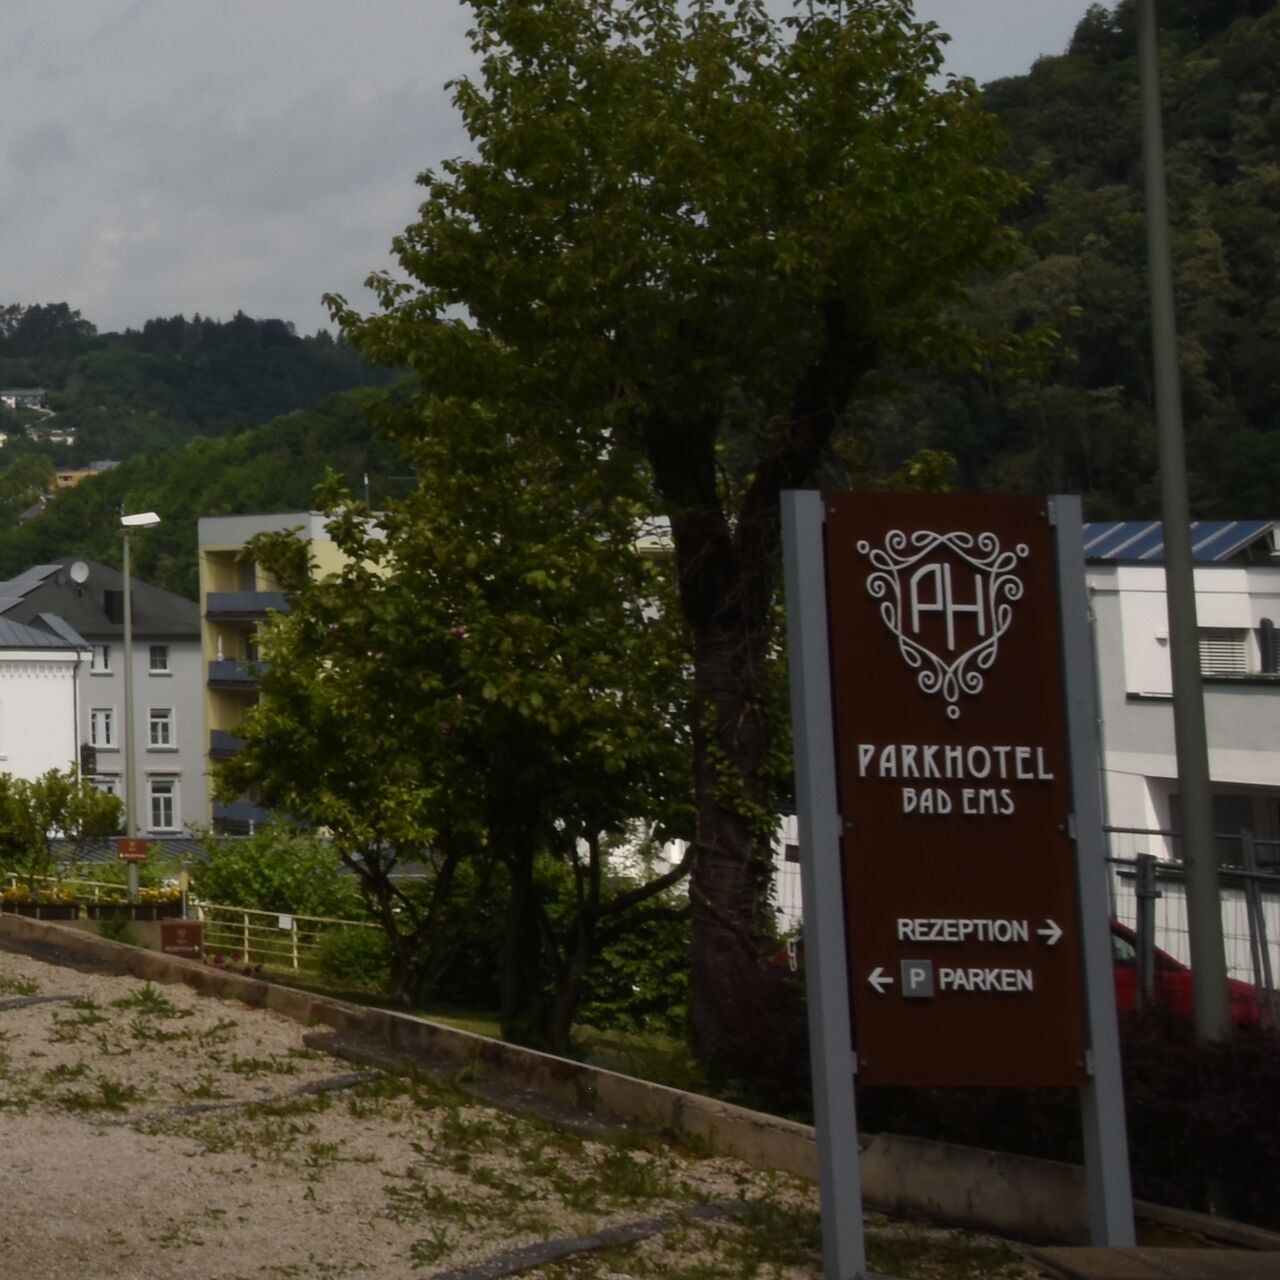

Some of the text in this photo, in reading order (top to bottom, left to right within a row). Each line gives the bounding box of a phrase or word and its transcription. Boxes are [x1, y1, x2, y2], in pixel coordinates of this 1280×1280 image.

[857, 743, 1055, 780] PARKHOTEL
[902, 787, 1015, 815] BAD EMS
[896, 918, 1029, 943] REZEPTION
[910, 967, 1034, 992] P PARKEN
